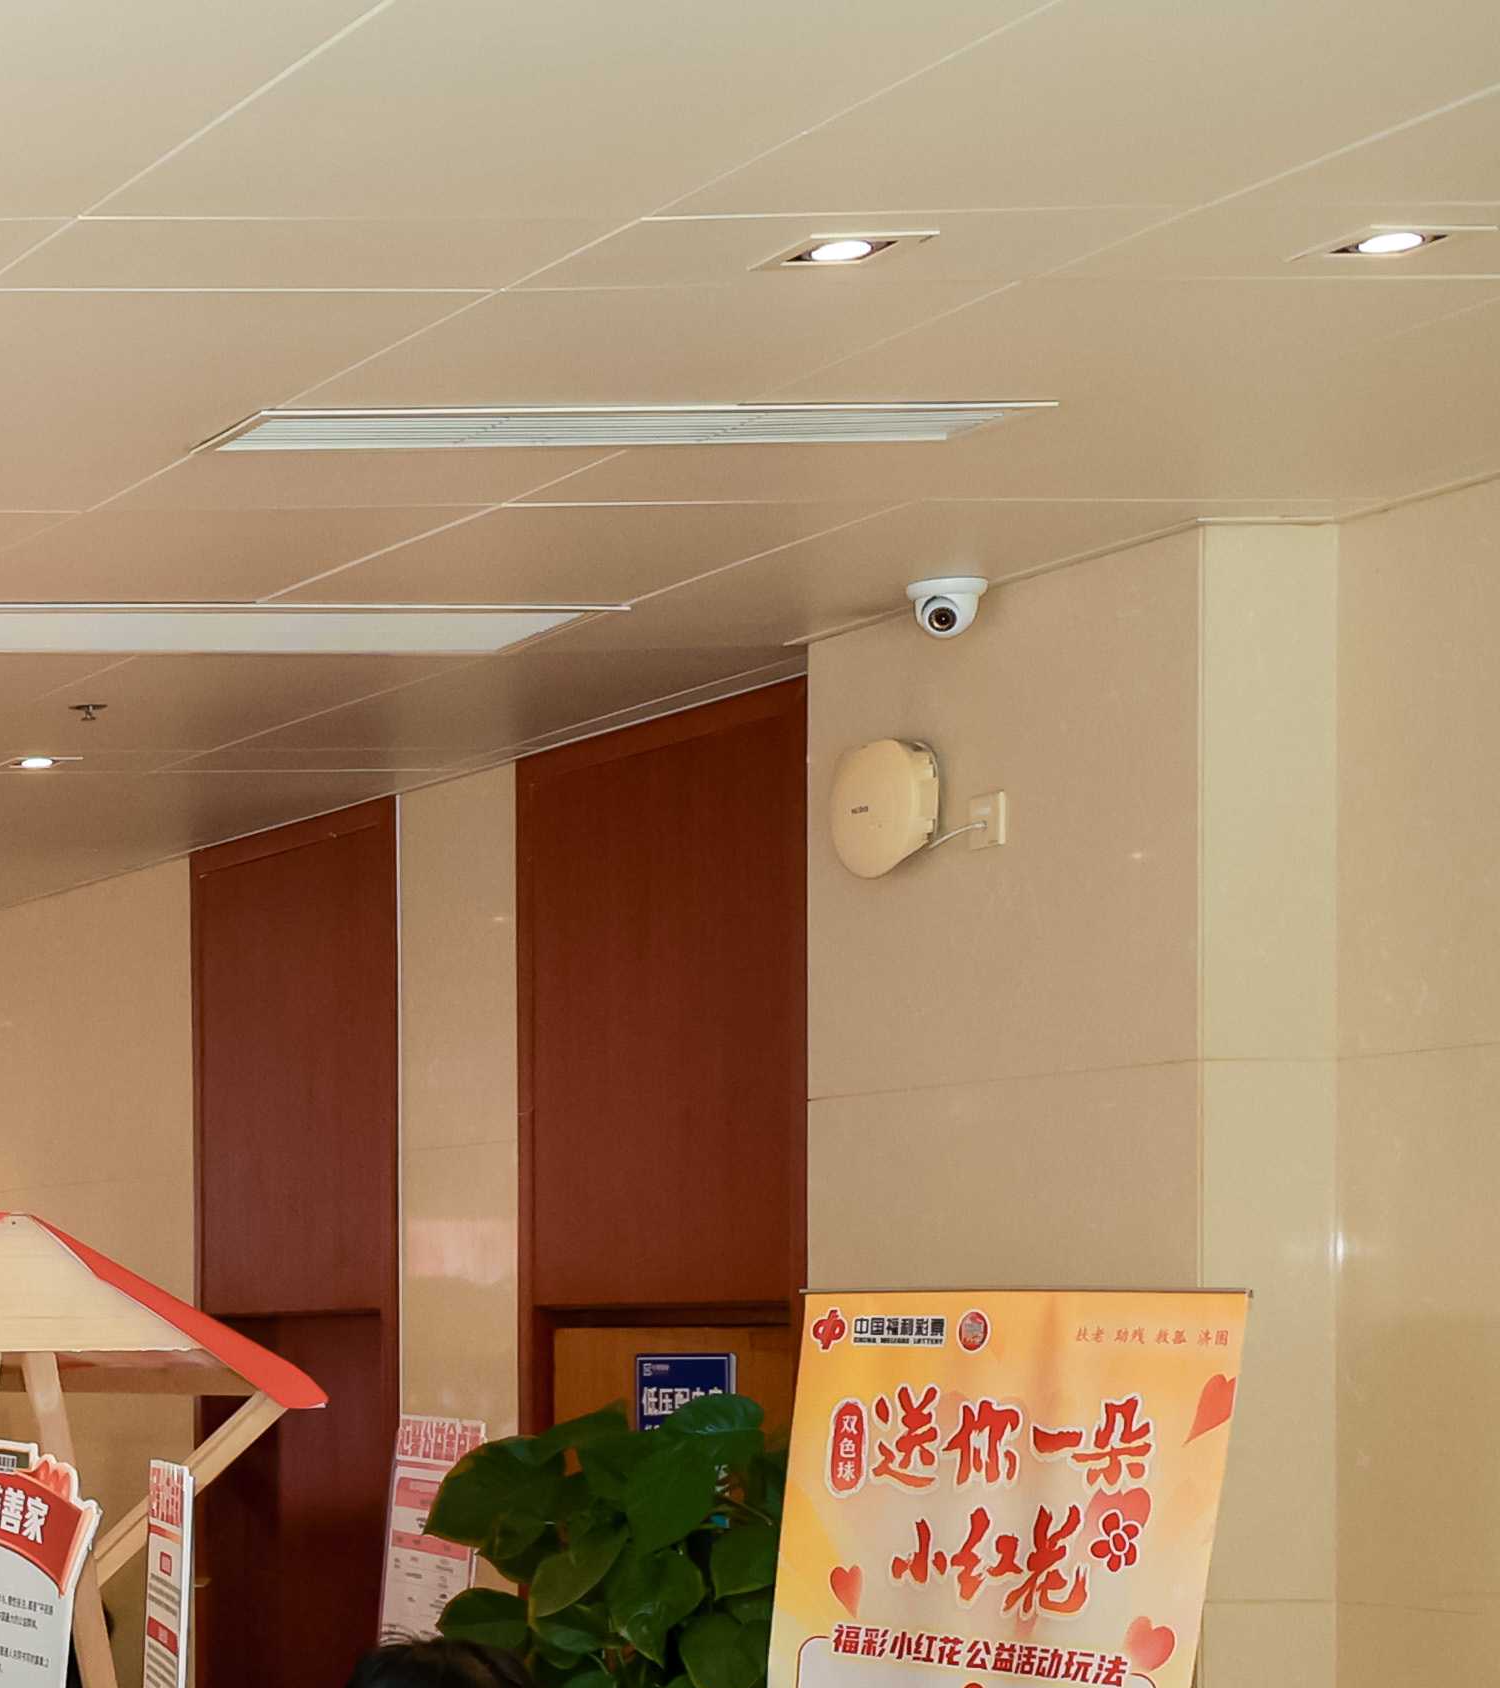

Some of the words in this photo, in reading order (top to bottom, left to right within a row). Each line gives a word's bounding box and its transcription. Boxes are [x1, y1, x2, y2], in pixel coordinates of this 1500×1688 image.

[854, 1317, 945, 1337] 中国福利彩票
[1076, 1327, 1106, 1344] 扶老
[1114, 1328, 1146, 1345] 助残
[1155, 1329, 1187, 1345] 救孤
[1197, 1330, 1230, 1346] 济困
[837, 1415, 858, 1481] 双色球
[872, 1386, 1152, 1488] 送你一朵
[892, 1504, 1088, 1613] 小红花
[833, 1624, 1128, 1687] 福彩小红花公益活动玩法
